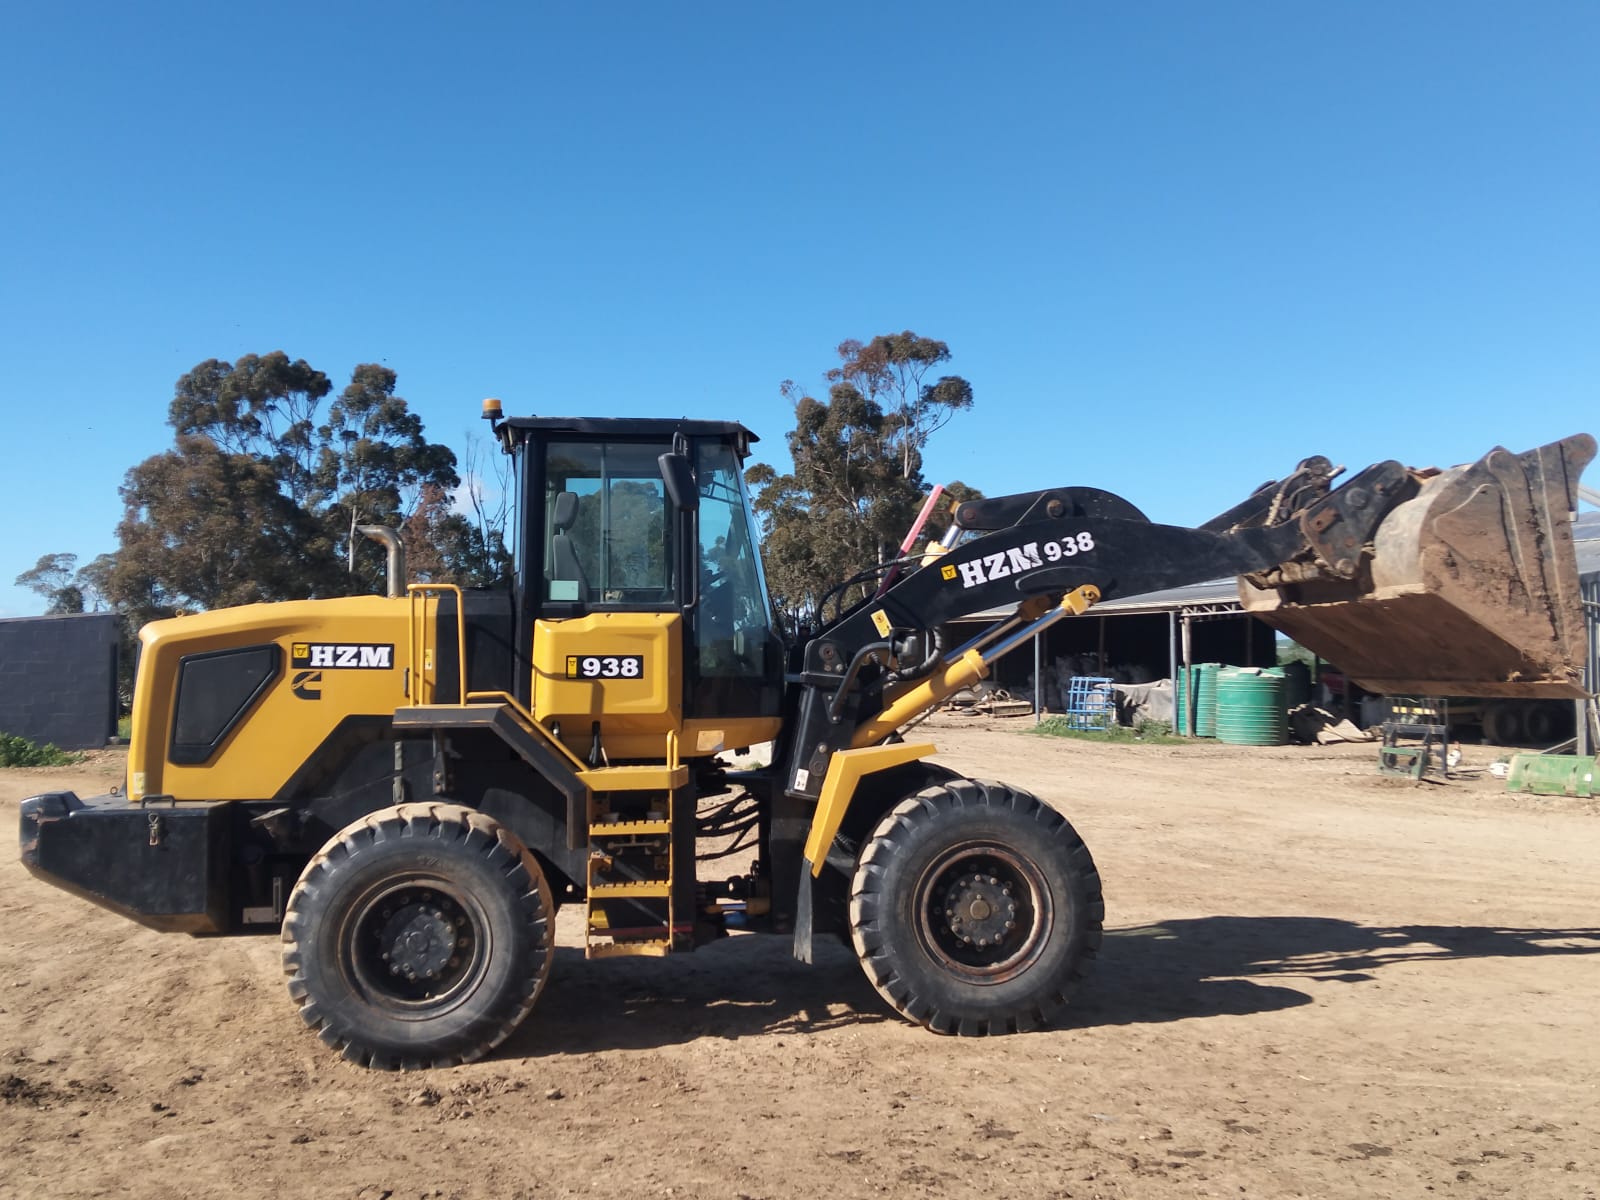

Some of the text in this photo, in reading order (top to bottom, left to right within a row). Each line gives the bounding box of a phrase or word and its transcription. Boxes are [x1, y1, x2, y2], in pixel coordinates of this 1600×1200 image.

[958, 531, 1095, 588] HZM 938
[310, 645, 391, 667] HZM
[582, 657, 639, 677] 938
